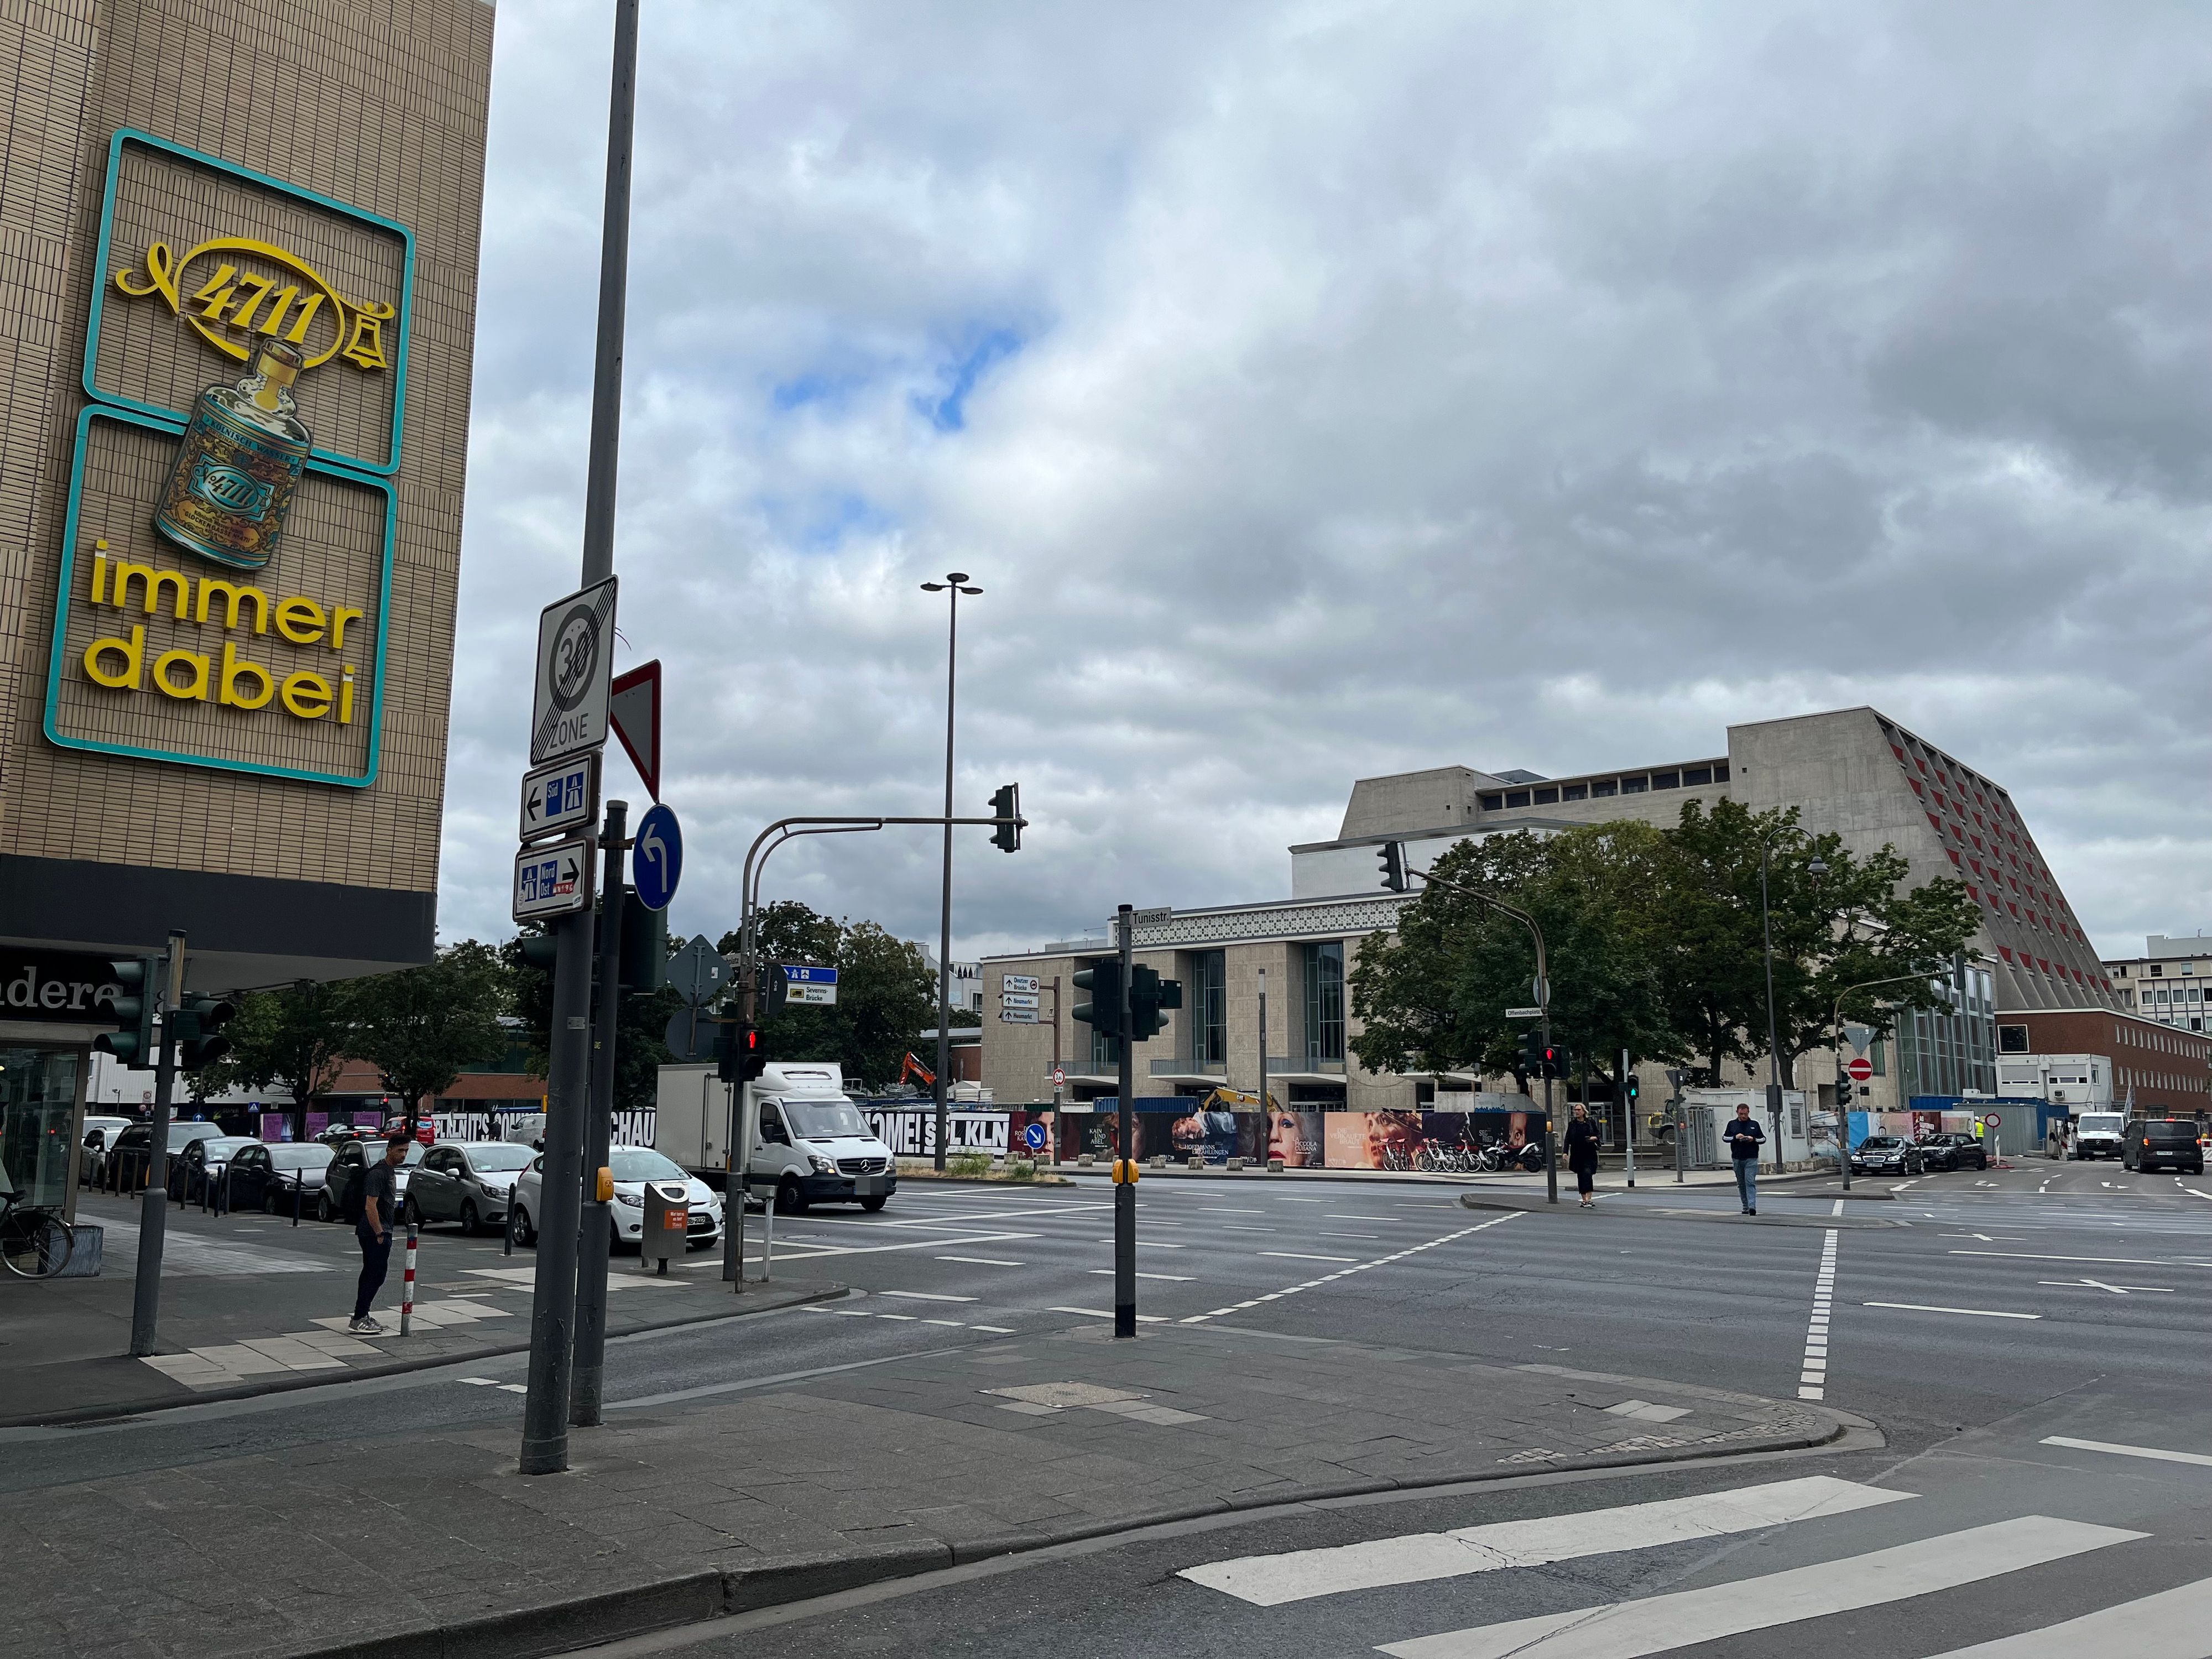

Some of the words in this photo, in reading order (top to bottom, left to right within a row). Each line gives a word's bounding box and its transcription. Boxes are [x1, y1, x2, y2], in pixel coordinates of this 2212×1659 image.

[191, 263, 326, 346] 4711
[257, 444, 291, 463] WASSER
[90, 539, 363, 651] immer
[83, 625, 355, 724] dabei
[559, 630, 587, 686] 30
[550, 713, 589, 749] ZONE
[540, 882, 550, 896] Ost
[541, 864, 556, 880] Nord
[1133, 911, 1169, 924] Tunisstr.
[0, 966, 122, 1010] dere
[611, 1112, 656, 1146] CHAU
[864, 1113, 921, 1154] OME!
[965, 1121, 1009, 1147] KLN
